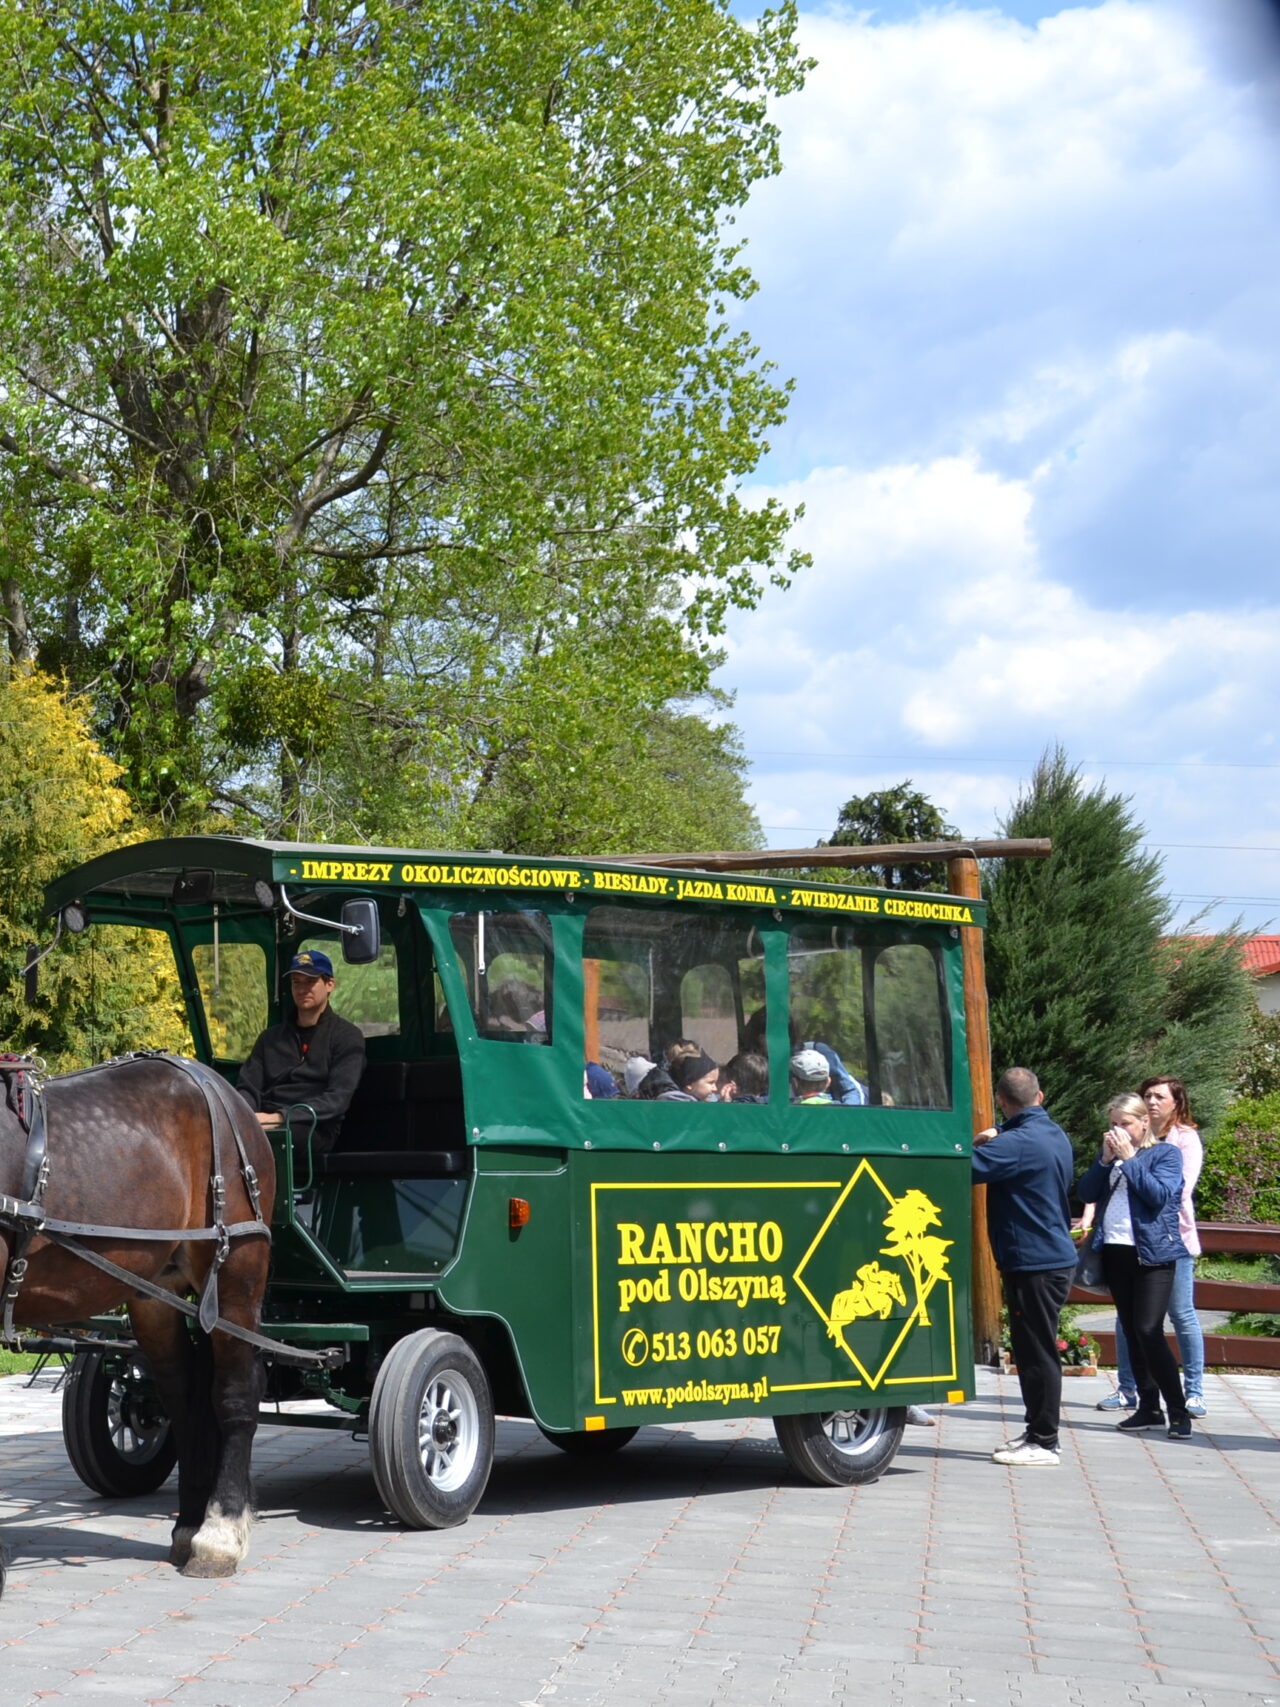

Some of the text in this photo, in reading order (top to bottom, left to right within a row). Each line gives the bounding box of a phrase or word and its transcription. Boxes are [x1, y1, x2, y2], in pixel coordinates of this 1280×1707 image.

[301, 860, 394, 882] IMPREZY
[401, 864, 582, 888] OKOLICZNOŚCIOWE
[676, 879, 725, 900] JAZDA
[725, 883, 777, 904] KONNA
[790, 889, 880, 914] ZWIEDZANIE
[883, 898, 974, 923] CIECHOCINKA
[616, 1220, 784, 1265] RANCHO
[617, 1266, 787, 1313] pod Olszyną
[651, 1324, 782, 1363] 513 063 057
[621, 1375, 769, 1409] www.podolszyna.pl
